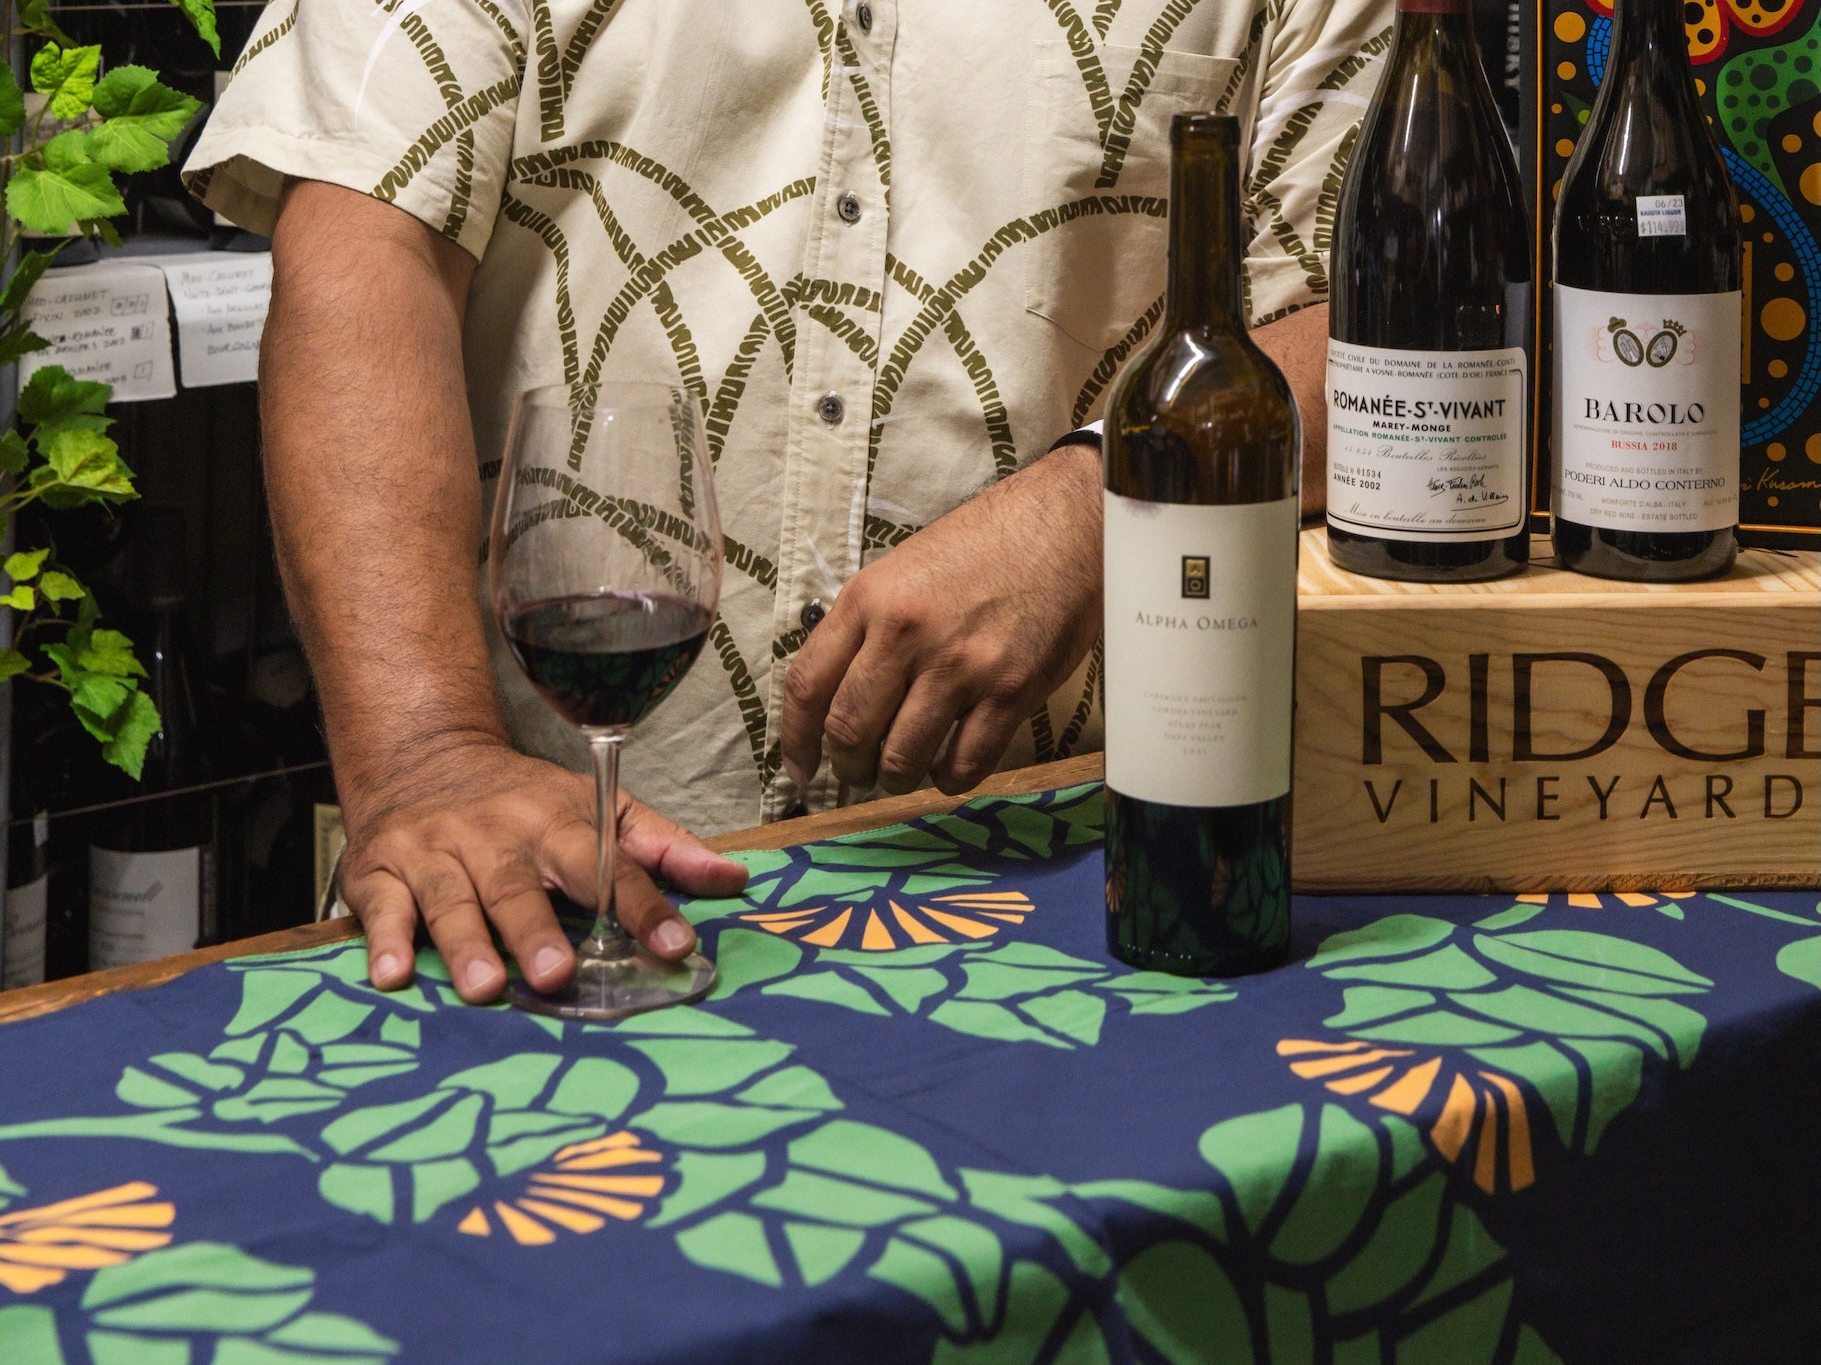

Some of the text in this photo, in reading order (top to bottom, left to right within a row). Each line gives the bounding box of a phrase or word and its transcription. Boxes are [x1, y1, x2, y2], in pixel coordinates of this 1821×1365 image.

[1655, 199, 1683, 208] 06/23
[1348, 354, 1365, 364] CIVILE
[1370, 357, 1379, 365] DU
[1385, 359, 1421, 368] DOMAINE
[1584, 397, 1705, 424] BAROLO
[1333, 424, 1368, 438] APPELLATION
[1372, 420, 1451, 432] MAREY-MONGE
[1611, 440, 1677, 450] BUSSIA 2018
[1376, 444, 1433, 461] Bouteilles
[1357, 467, 1381, 479] 01534
[1585, 462, 1619, 473] PRODUCED
[1334, 473, 1381, 490] ANNÉE 2002
[1564, 469, 1605, 486] PODERI
[1609, 478, 1650, 490] ALDO
[1655, 477, 1725, 490] CONTERNO
[1601, 498, 1637, 507] MONFORTE
[1603, 510, 1617, 518] RED
[1361, 648, 1821, 765] RIDGE
[1363, 774, 1804, 824] VINEYARD
